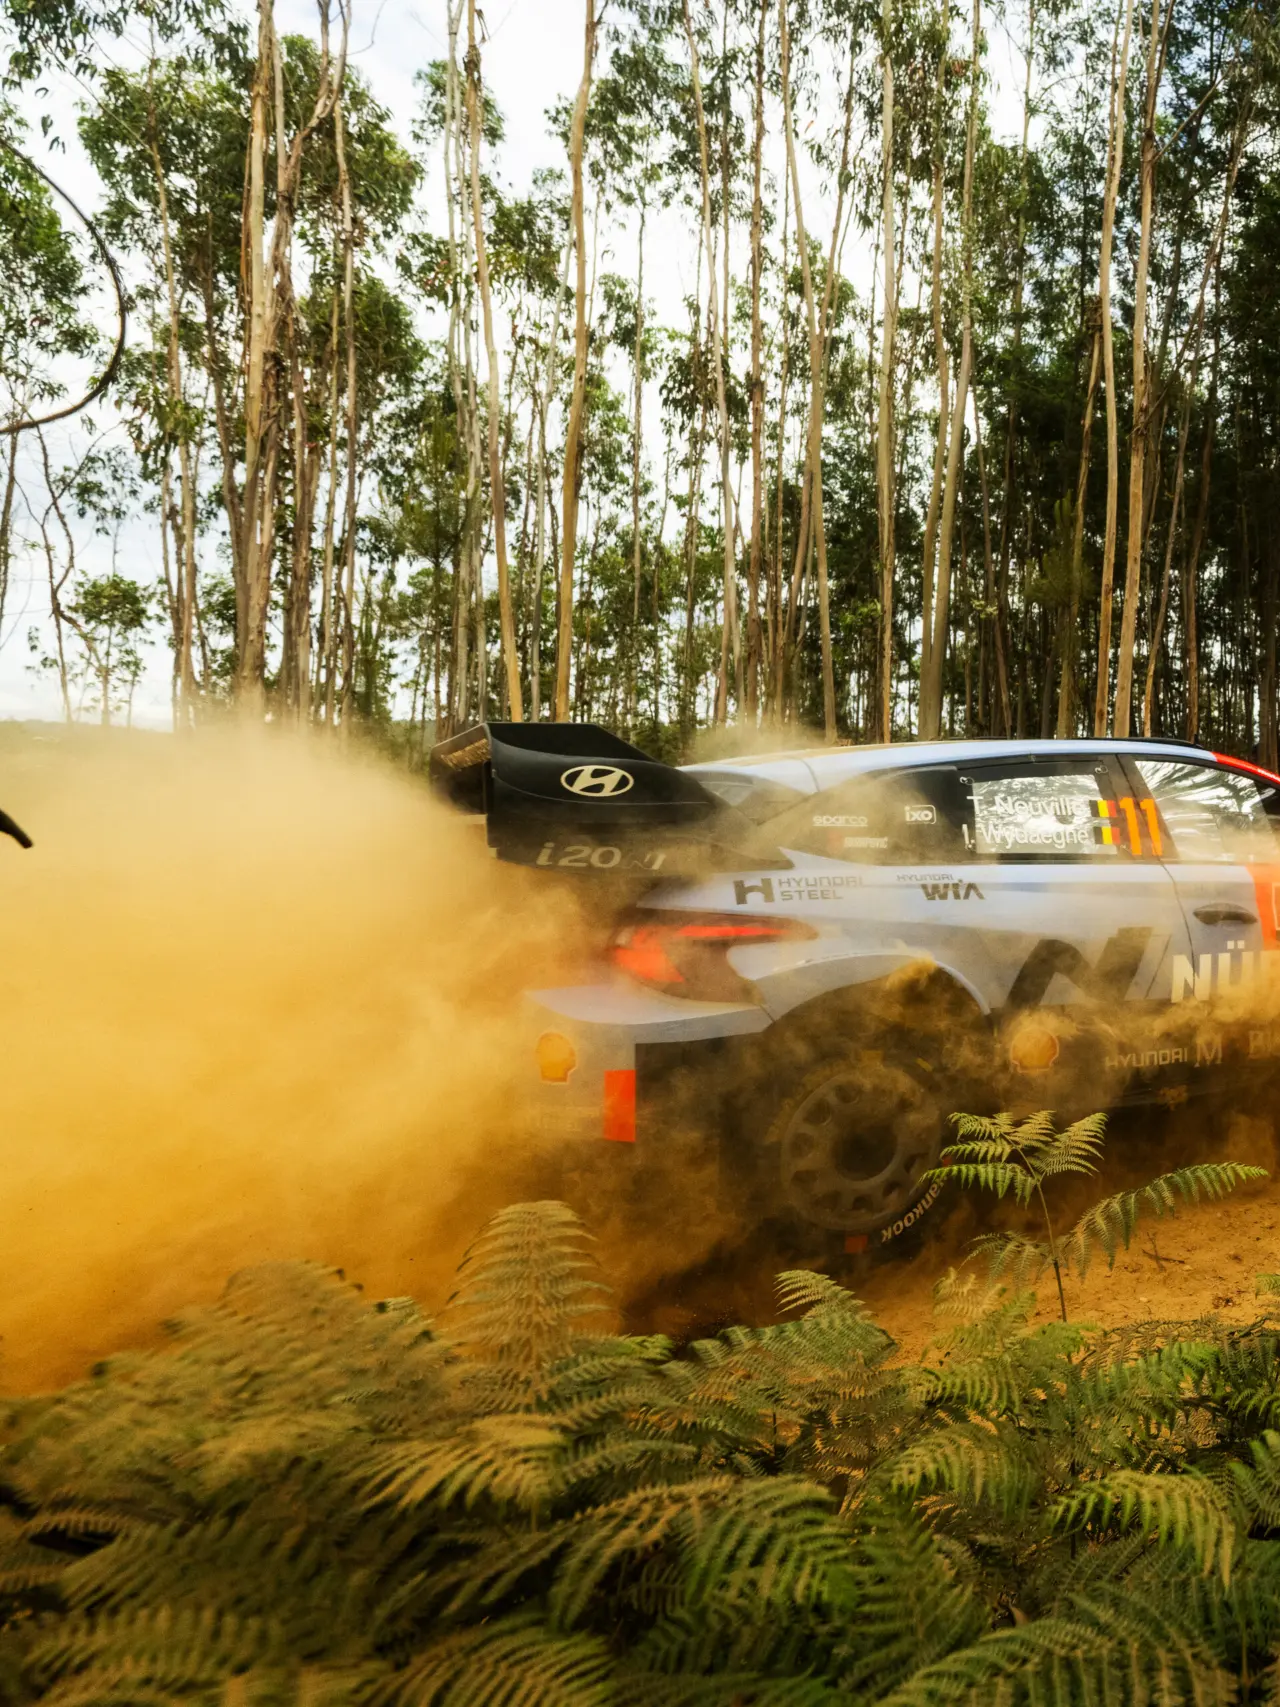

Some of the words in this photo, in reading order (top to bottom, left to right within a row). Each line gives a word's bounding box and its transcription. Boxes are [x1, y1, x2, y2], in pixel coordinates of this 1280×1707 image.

[994, 796, 1087, 816] Neuville
[813, 815, 868, 826] sparco
[1119, 797, 1163, 856] 11
[536, 842, 621, 868] i20
[778, 875, 863, 887] HYUNDAI
[895, 873, 954, 881] HYUNDAI
[780, 889, 844, 901] STEEL
[1105, 1048, 1187, 1067] HYUNDAI
